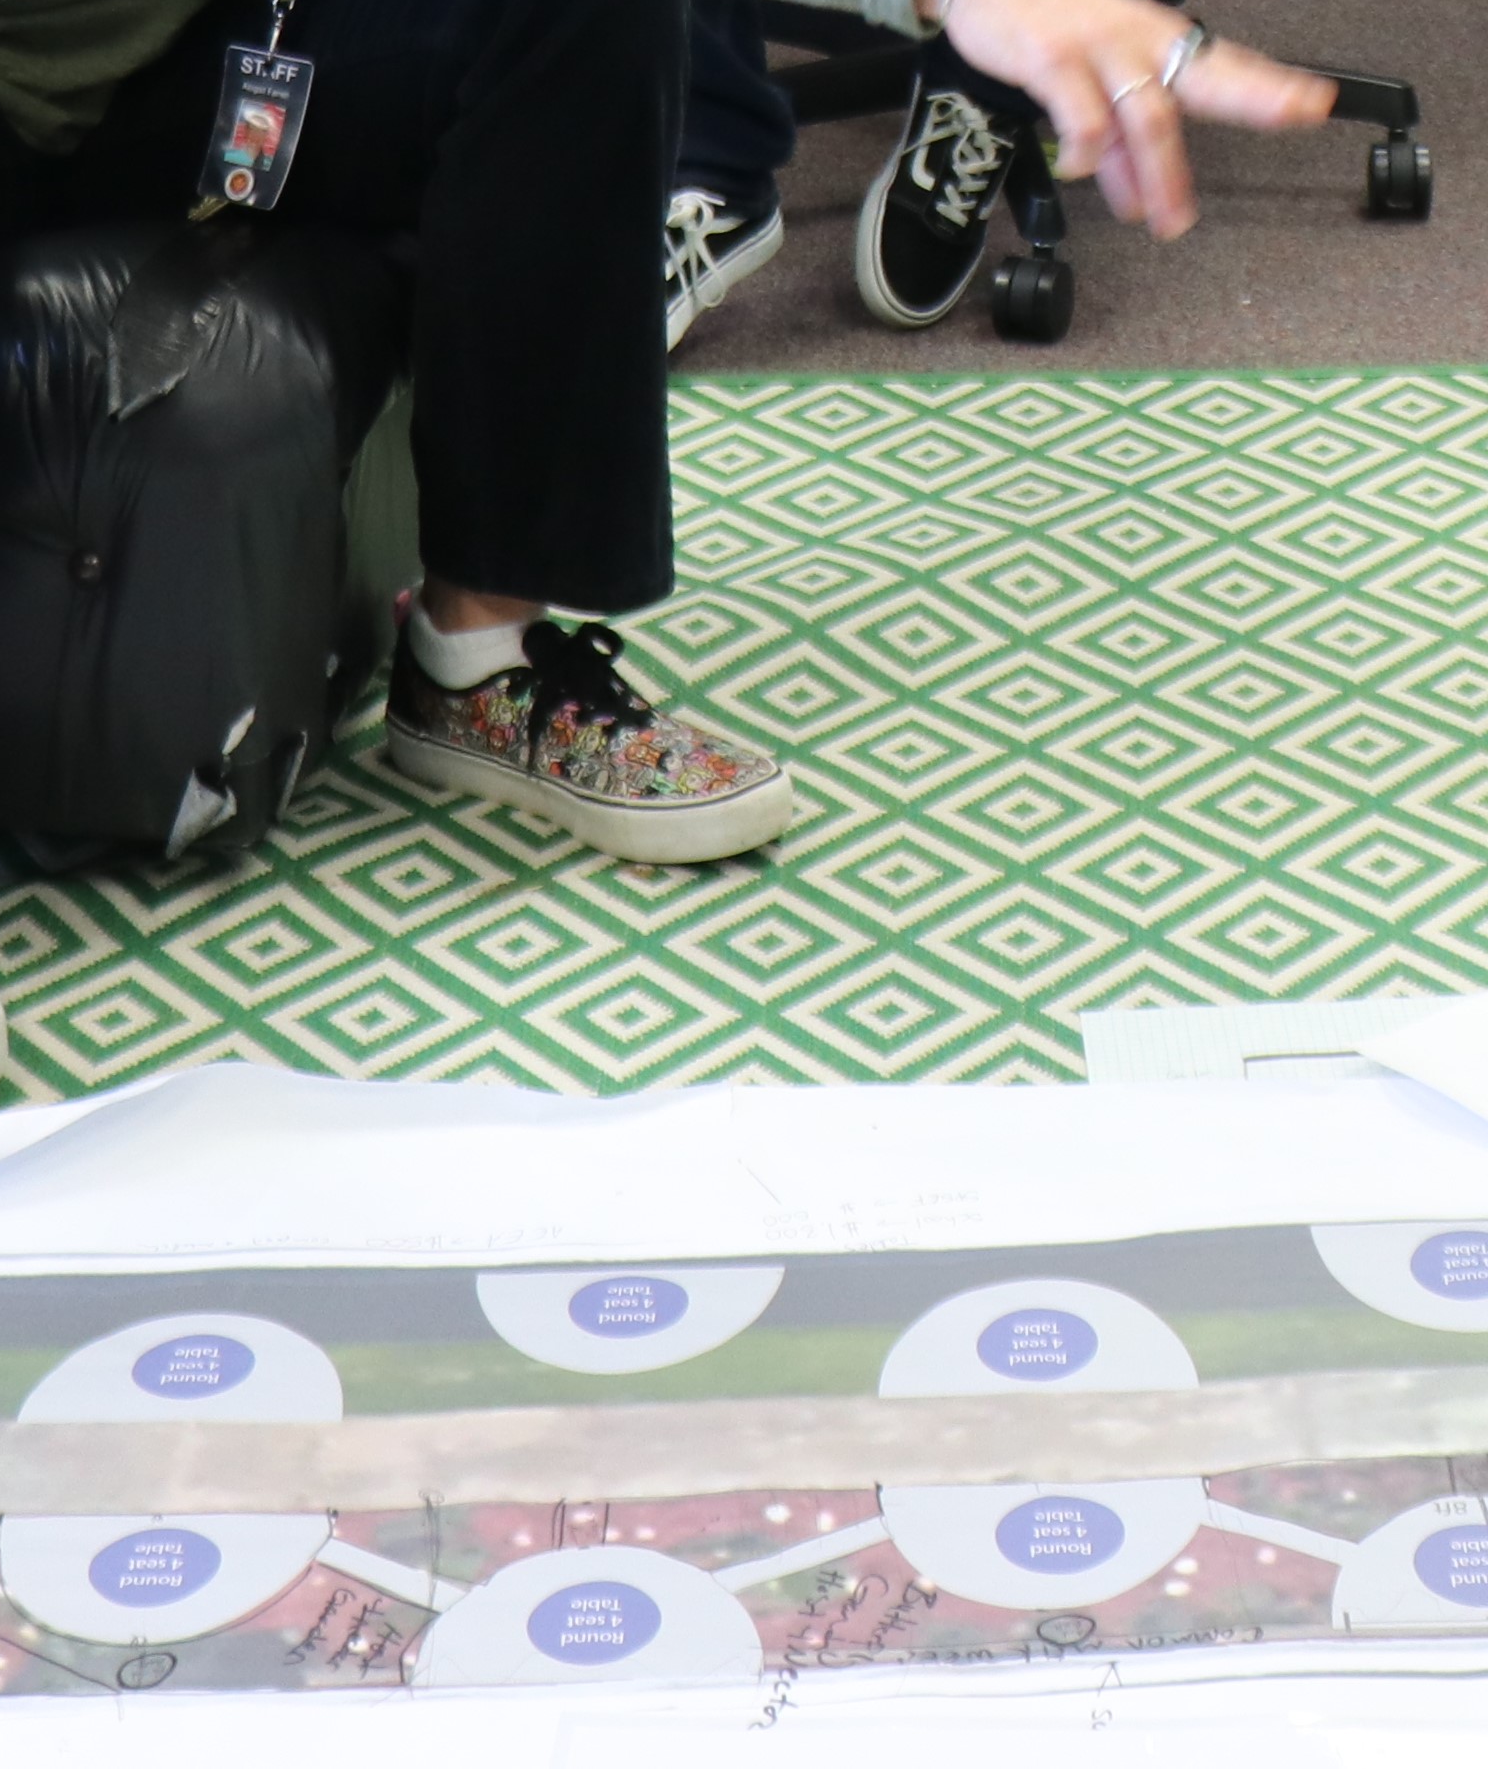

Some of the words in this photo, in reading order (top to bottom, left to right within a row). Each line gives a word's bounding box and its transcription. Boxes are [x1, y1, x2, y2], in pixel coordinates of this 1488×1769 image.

[1445, 1243, 1488, 1257] Table
[1444, 1259, 1480, 1270] seat
[607, 1286, 653, 1297] Table
[604, 1298, 639, 1310] seat
[641, 1298, 654, 1309] 4
[598, 1312, 656, 1325] Round
[1013, 1323, 1060, 1335] Table
[1011, 1339, 1049, 1350] seat
[1053, 1338, 1064, 1349] 4
[174, 1348, 219, 1359] Table
[209, 1361, 220, 1371] 4
[1009, 1353, 1068, 1367] Round
[169, 1361, 207, 1373] seat
[160, 1373, 220, 1385] Round
[1433, 1500, 1469, 1517] 8ft
[1034, 1511, 1085, 1523] Table
[1033, 1527, 1073, 1539] seat
[1075, 1526, 1088, 1538] 4
[134, 1542, 184, 1555] Table
[1030, 1542, 1093, 1558] Round
[128, 1559, 167, 1571] seat
[171, 1559, 184, 1571] 4
[119, 1574, 183, 1588] Round
[571, 1598, 622, 1611] Table
[567, 1616, 608, 1628] seat
[610, 1615, 623, 1627] 4
[560, 1631, 625, 1647] Round
